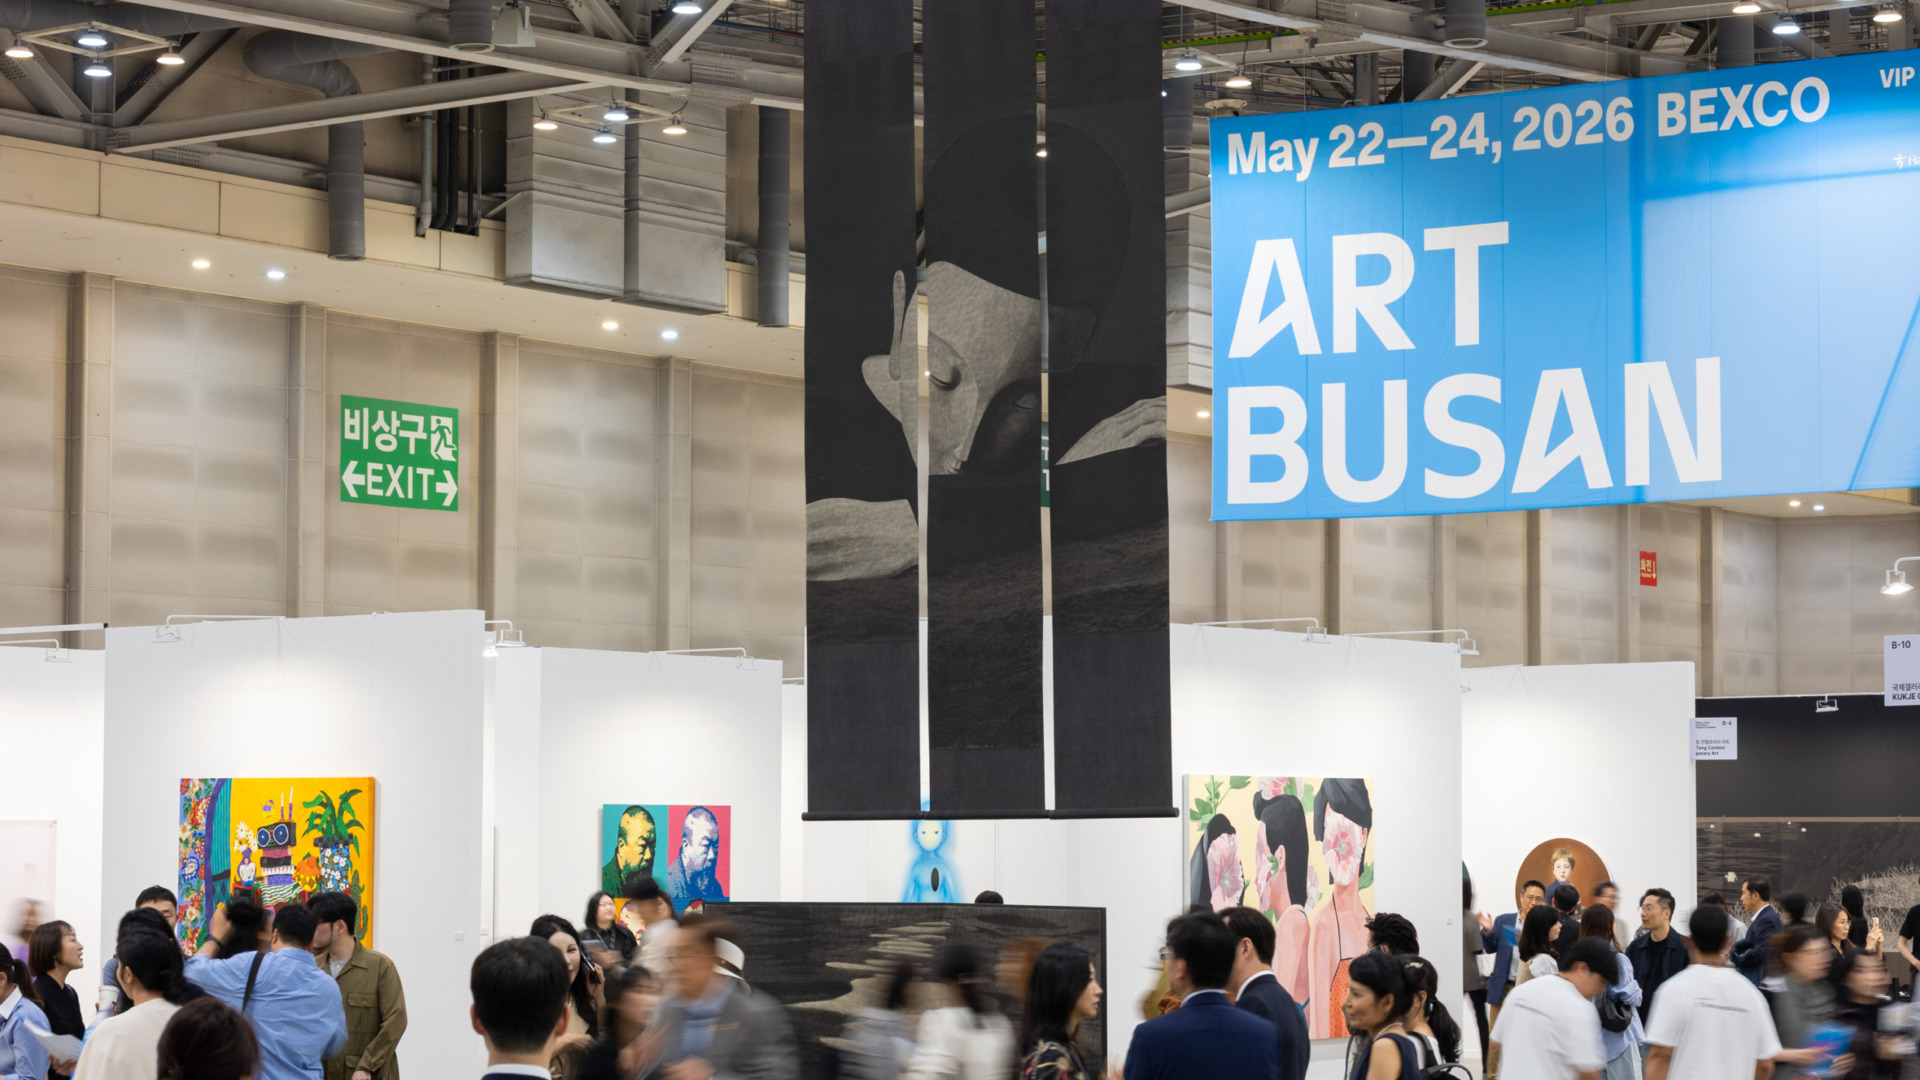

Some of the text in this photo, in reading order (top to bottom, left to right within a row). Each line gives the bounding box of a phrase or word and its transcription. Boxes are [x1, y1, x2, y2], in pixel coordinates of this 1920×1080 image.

[1880, 66, 1915, 88] VIP
[1228, 131, 1319, 182] May
[1513, 96, 1635, 151] 2026
[1657, 77, 1830, 137] BEXCO
[1229, 221, 1509, 358] ART
[344, 407, 427, 455] 비상구
[1227, 356, 1722, 504] BUSAN
[367, 462, 435, 501] EXIT
[1891, 640, 1911, 649] B-10
